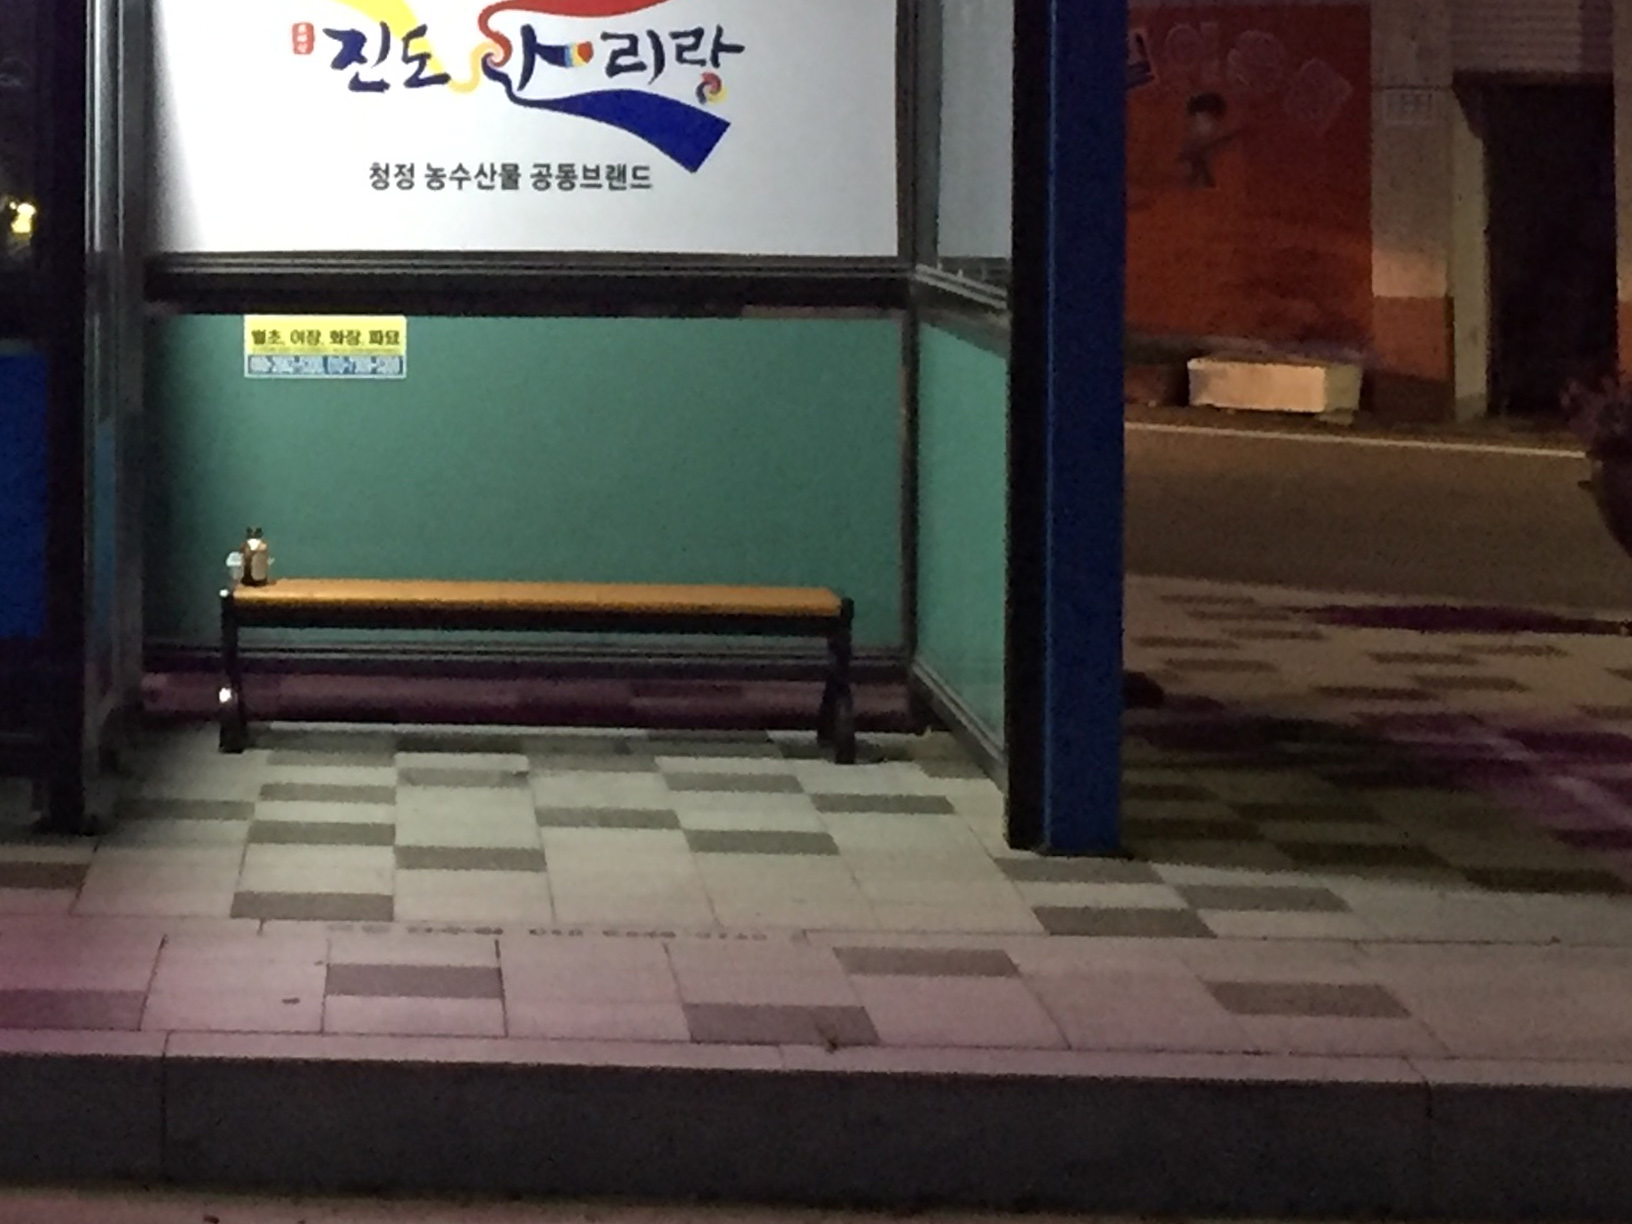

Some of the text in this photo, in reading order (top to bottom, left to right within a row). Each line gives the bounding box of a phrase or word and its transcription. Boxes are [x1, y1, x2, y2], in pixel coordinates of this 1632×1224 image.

[322, 21, 451, 92] 진도
[369, 162, 654, 192] 청정 농수산물 공동브랜드
